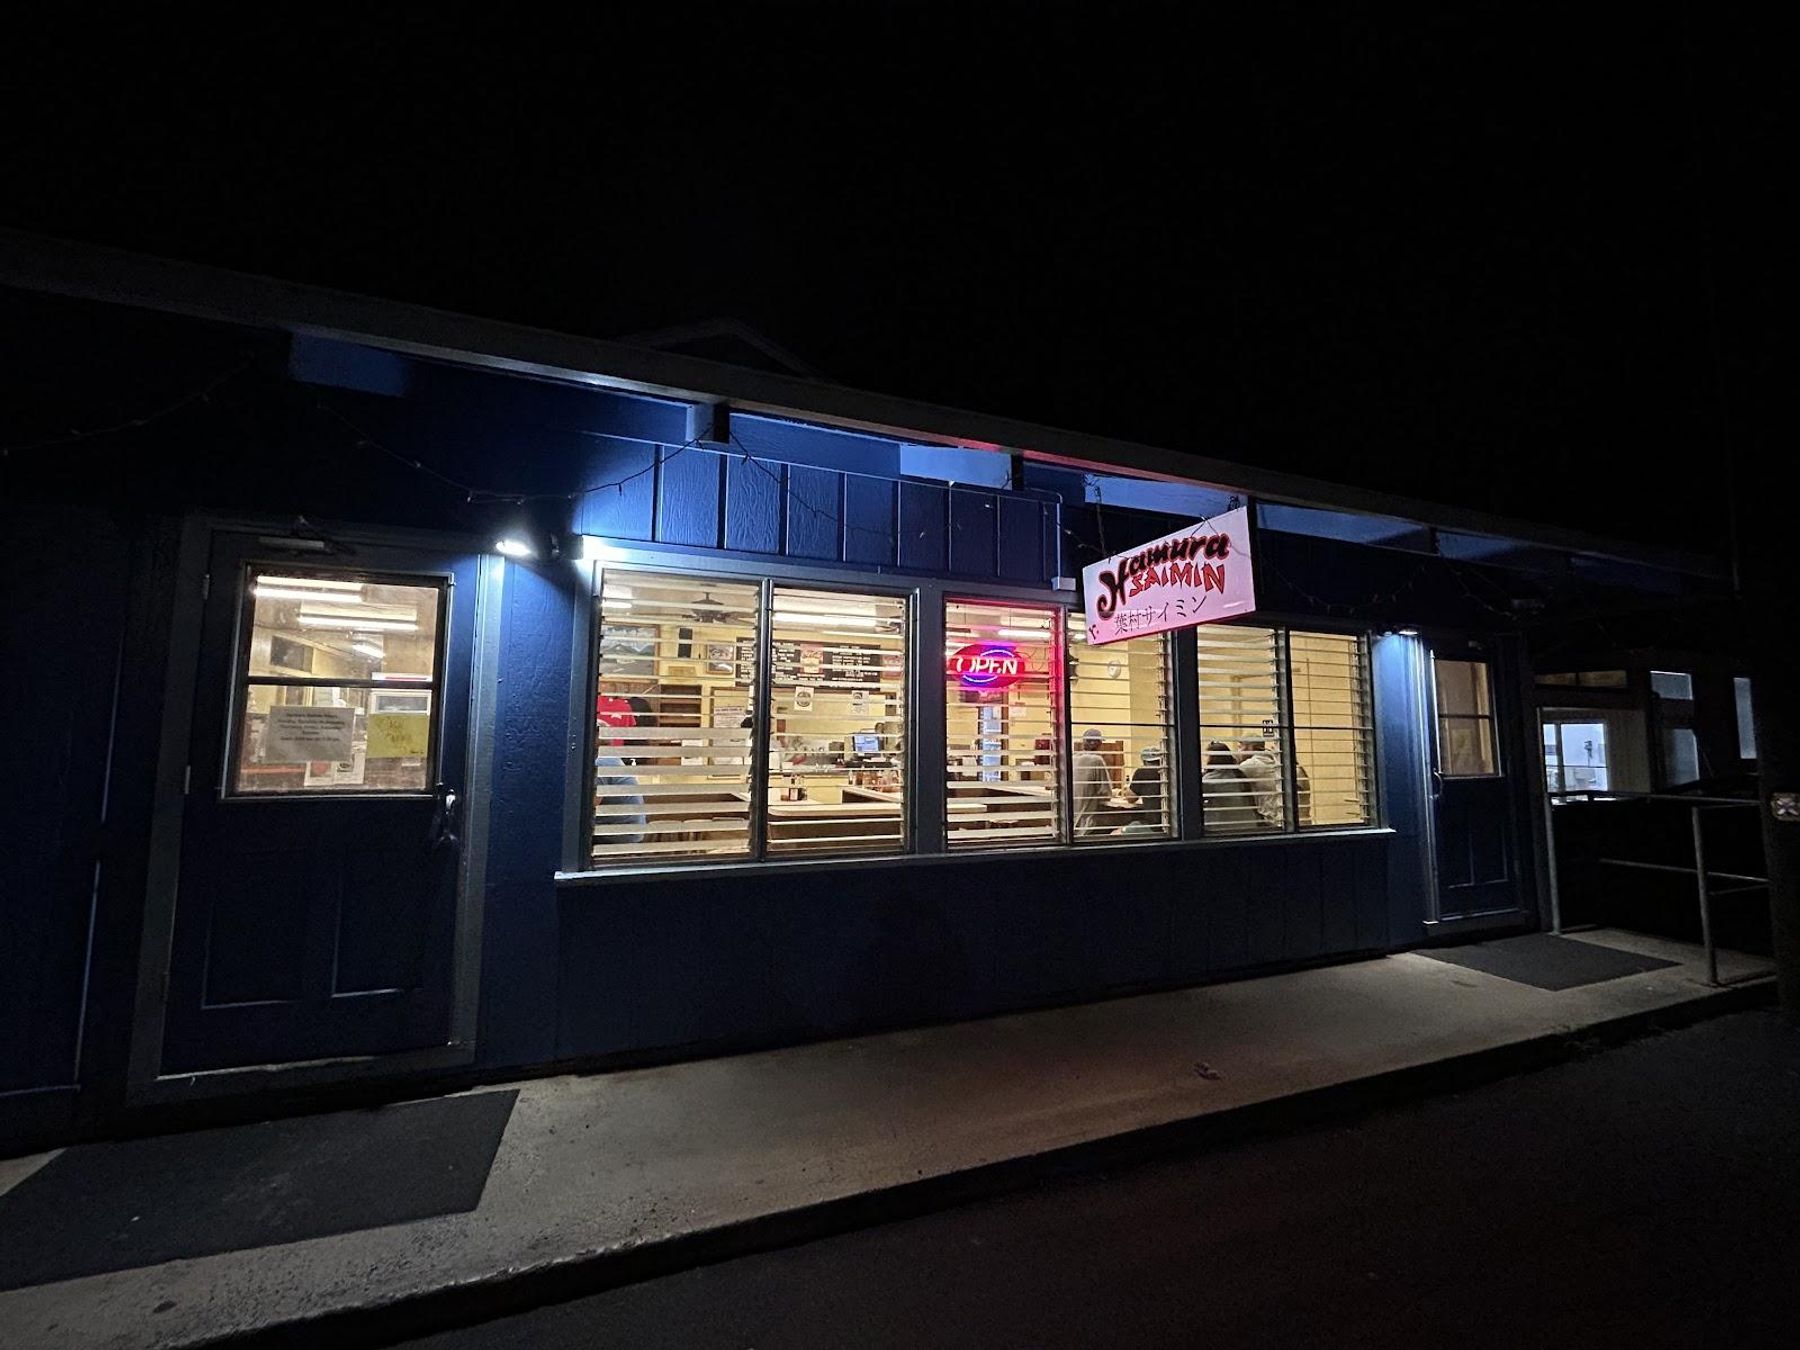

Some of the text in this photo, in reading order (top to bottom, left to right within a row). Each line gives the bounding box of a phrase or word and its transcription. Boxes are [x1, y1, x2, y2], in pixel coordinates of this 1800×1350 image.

[1096, 533, 1231, 620] Hamura
[1129, 562, 1225, 597] SAIMIN
[956, 656, 1018, 675] OPEN
